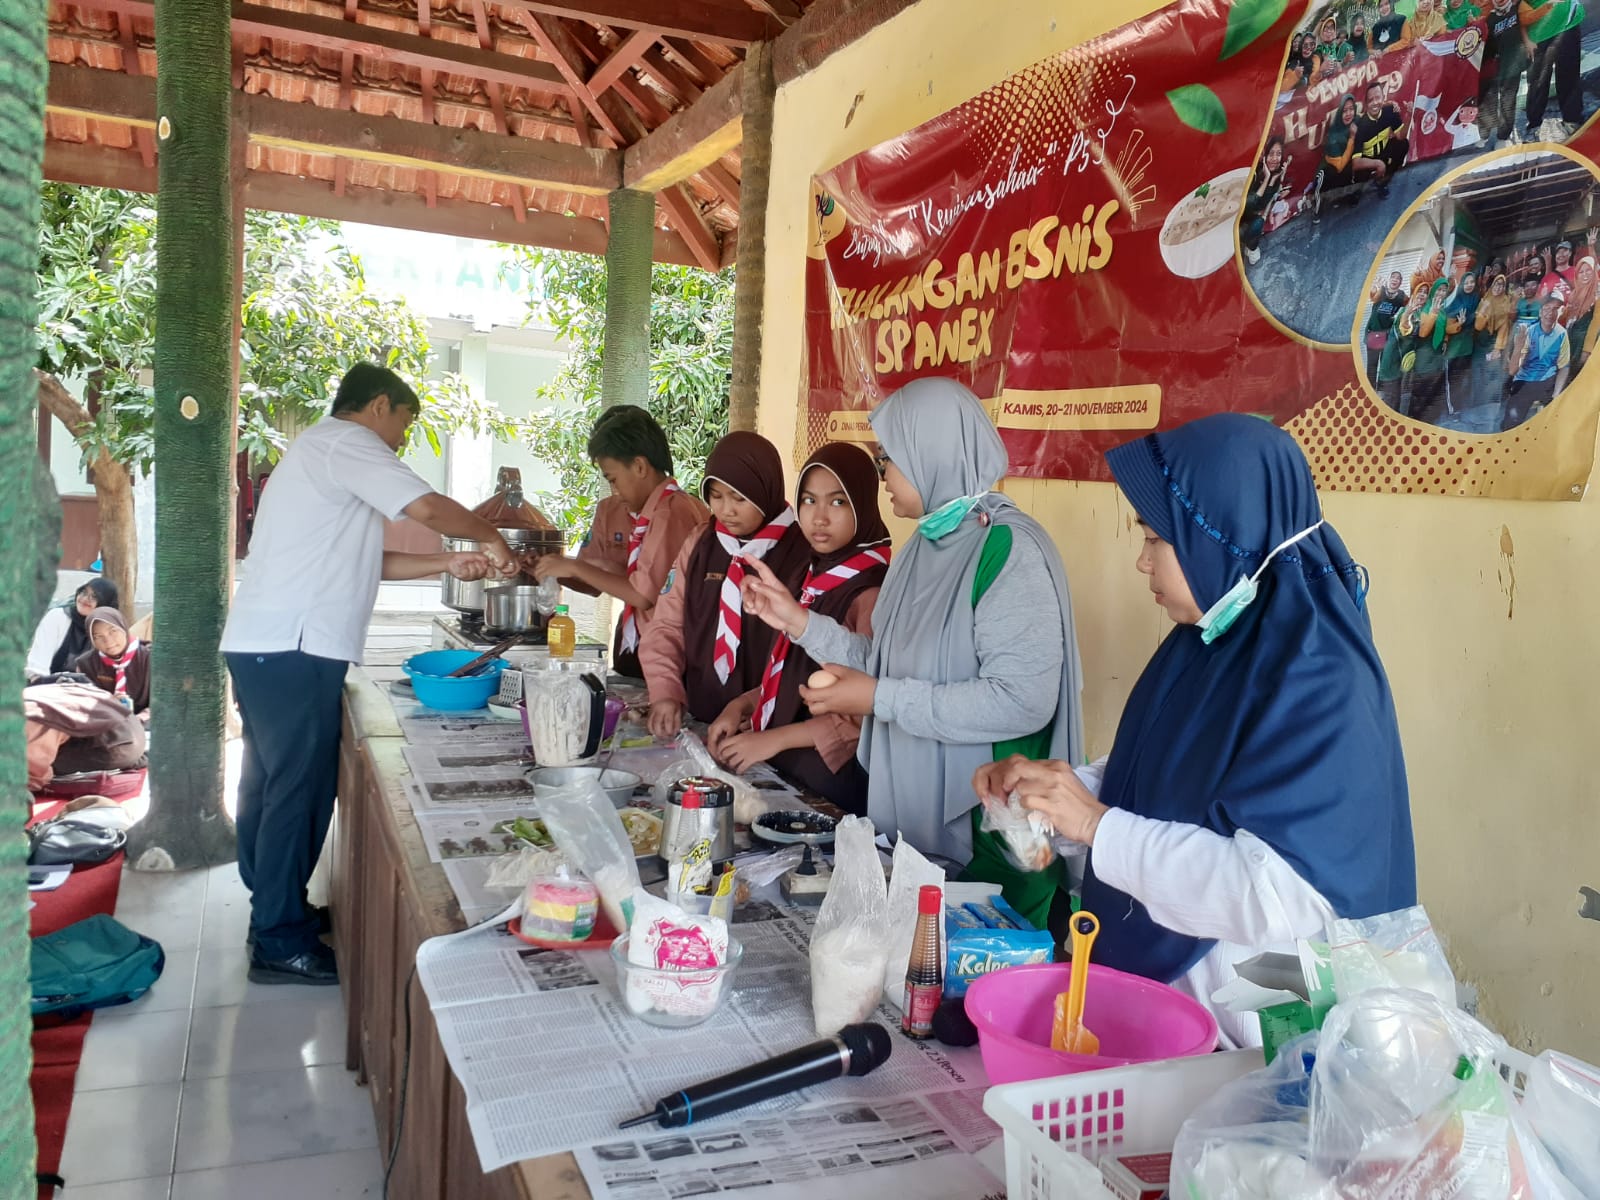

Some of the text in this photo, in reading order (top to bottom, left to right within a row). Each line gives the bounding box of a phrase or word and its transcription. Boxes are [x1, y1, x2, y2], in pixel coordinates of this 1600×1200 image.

[1003, 402, 1045, 417] KAMIS,
[1073, 402, 1123, 416] NOVEMBER
[1124, 399, 1148, 414] 2024
